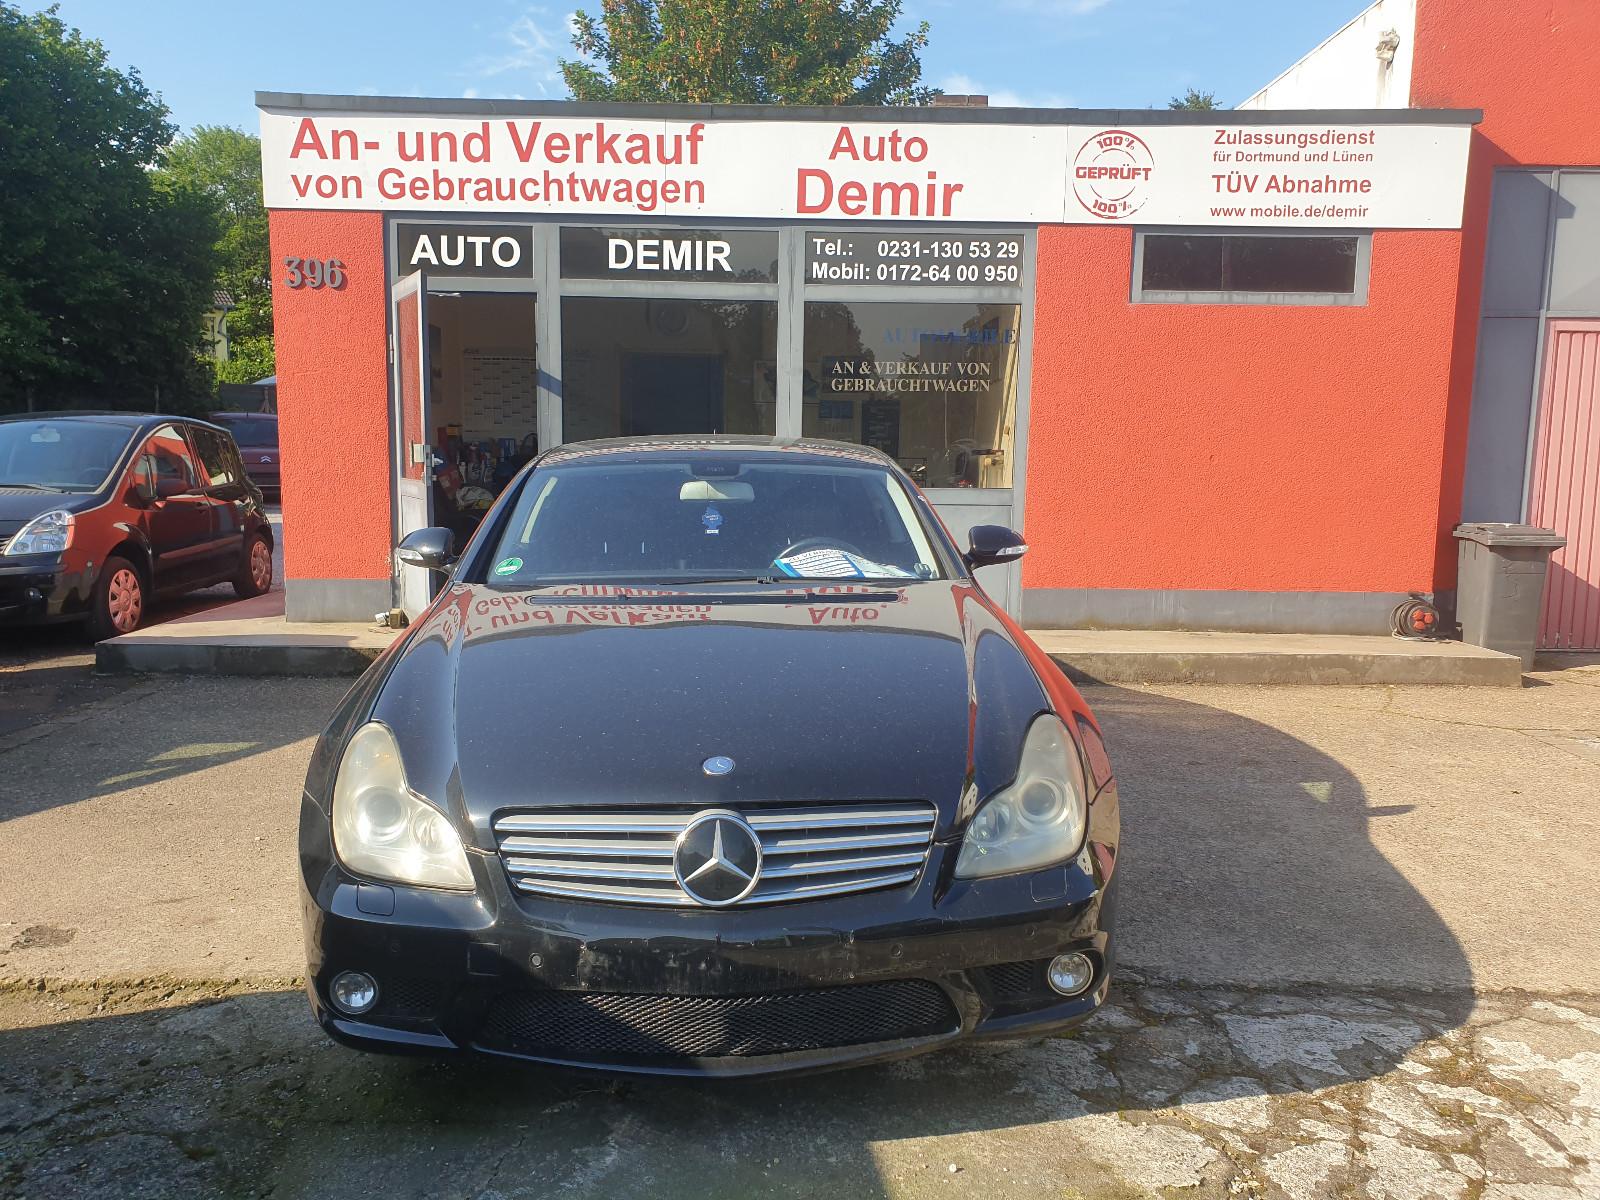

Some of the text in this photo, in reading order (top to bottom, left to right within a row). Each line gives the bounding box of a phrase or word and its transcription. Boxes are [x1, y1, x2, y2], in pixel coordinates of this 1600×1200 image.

[290, 118, 704, 165] An- und Verkauf
[829, 127, 928, 162] Auto
[1096, 135, 1135, 149] 100%
[1213, 129, 1376, 149] Zulassungsdienst
[1213, 151, 1373, 162] für Dortmund und Lünen
[1075, 164, 1152, 181] GEPRÜFT
[291, 167, 705, 212] von Gebrauchtwagen
[797, 168, 964, 216] Demir
[1211, 171, 1372, 194] TÜV Abnahme
[1091, 199, 1132, 214] 100%
[1250, 204, 1369, 218] mobile.de/demir
[411, 235, 520, 267] AUTO
[609, 239, 732, 271] DEMIR
[813, 239, 1018, 258] Tel.: 0231-130 53 29
[283, 256, 343, 288] 396
[813, 262, 1017, 281] Mobil: 0172-64 00 950
[832, 361, 991, 376] AN & VERKAUF VON
[831, 378, 990, 392] GEBRAUCHTWAGEN
